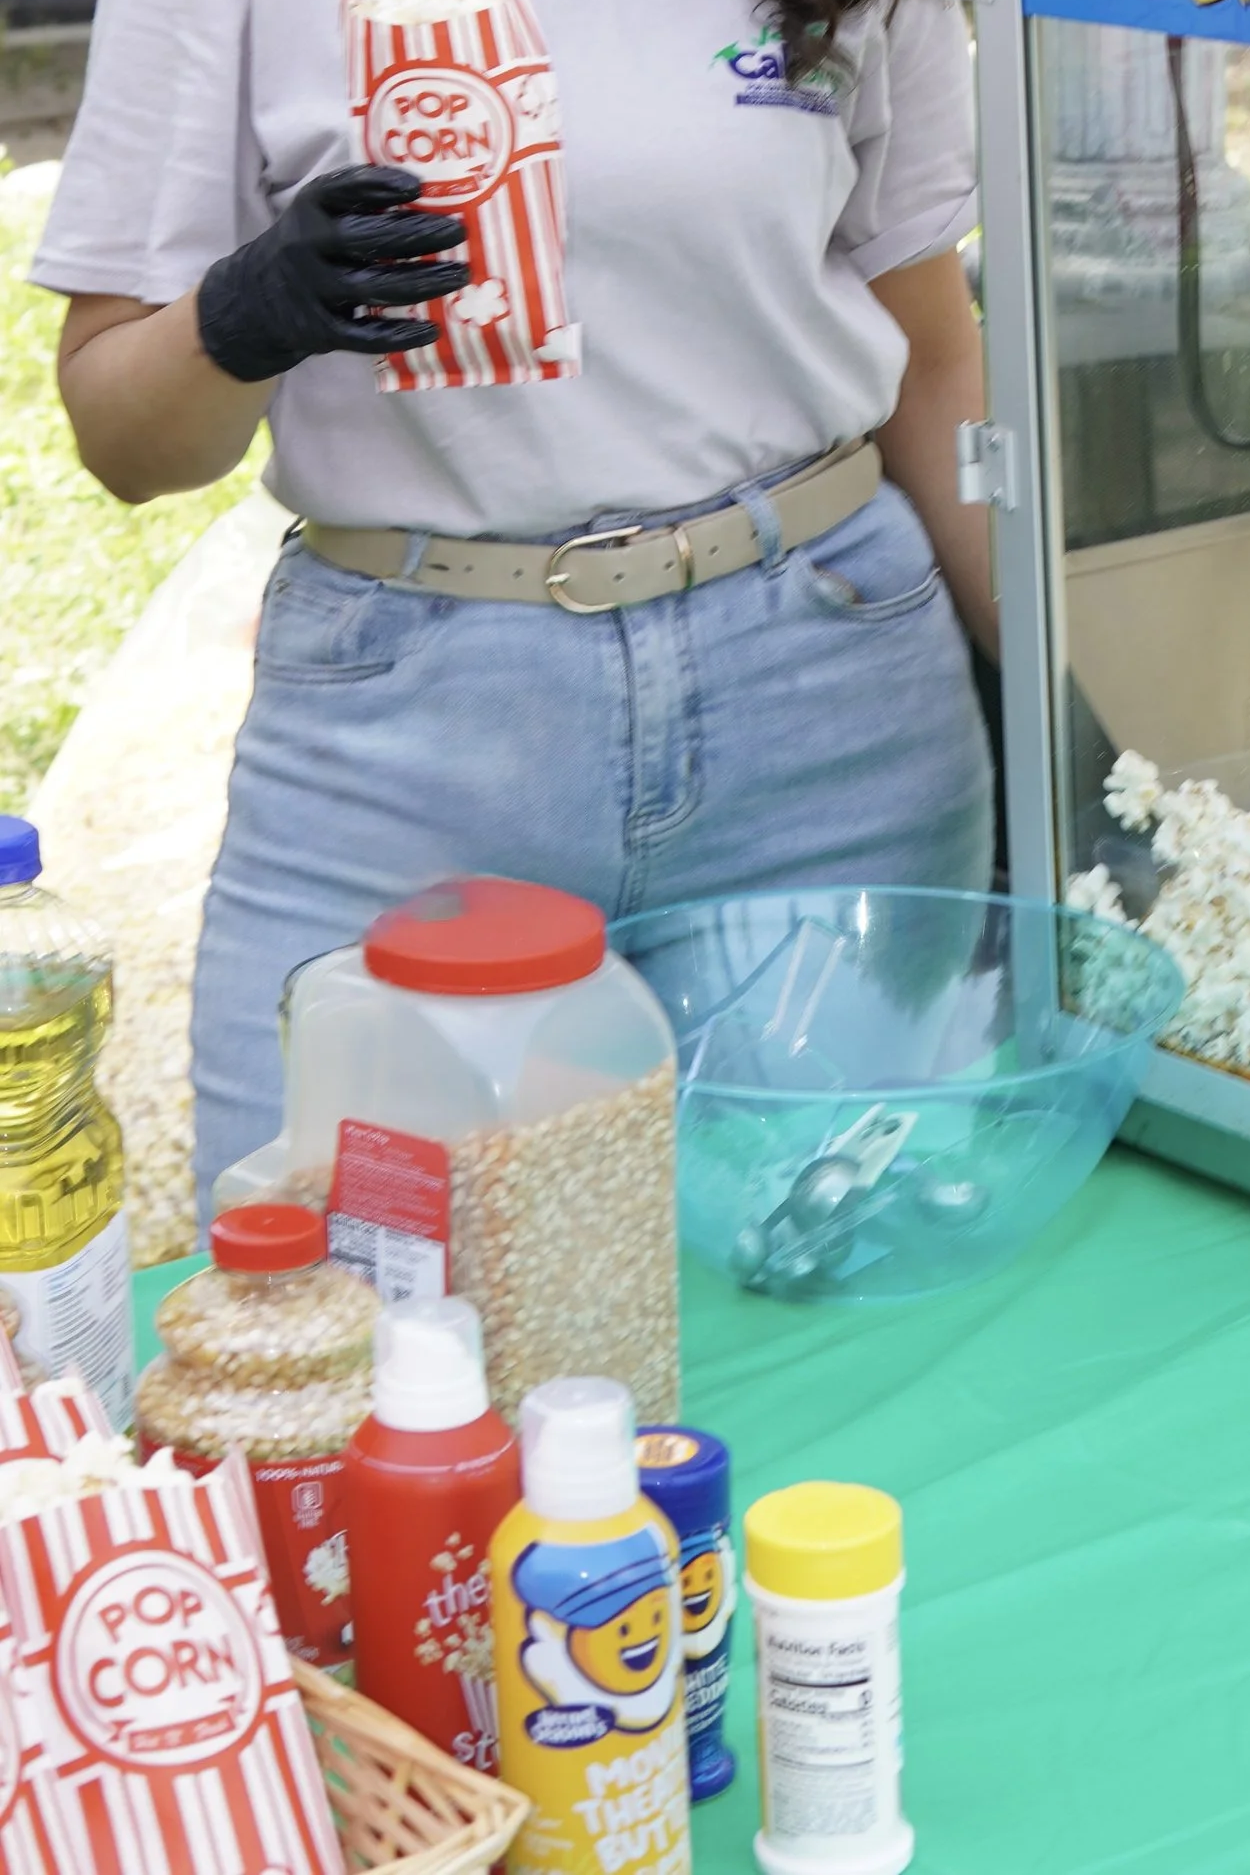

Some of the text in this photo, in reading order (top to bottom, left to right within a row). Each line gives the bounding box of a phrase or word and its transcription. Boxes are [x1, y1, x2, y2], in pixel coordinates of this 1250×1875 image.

[394, 91, 469, 122] POP
[385, 120, 491, 163] CORN
[98, 1585, 202, 1644] POP
[88, 1633, 238, 1708] CORN
